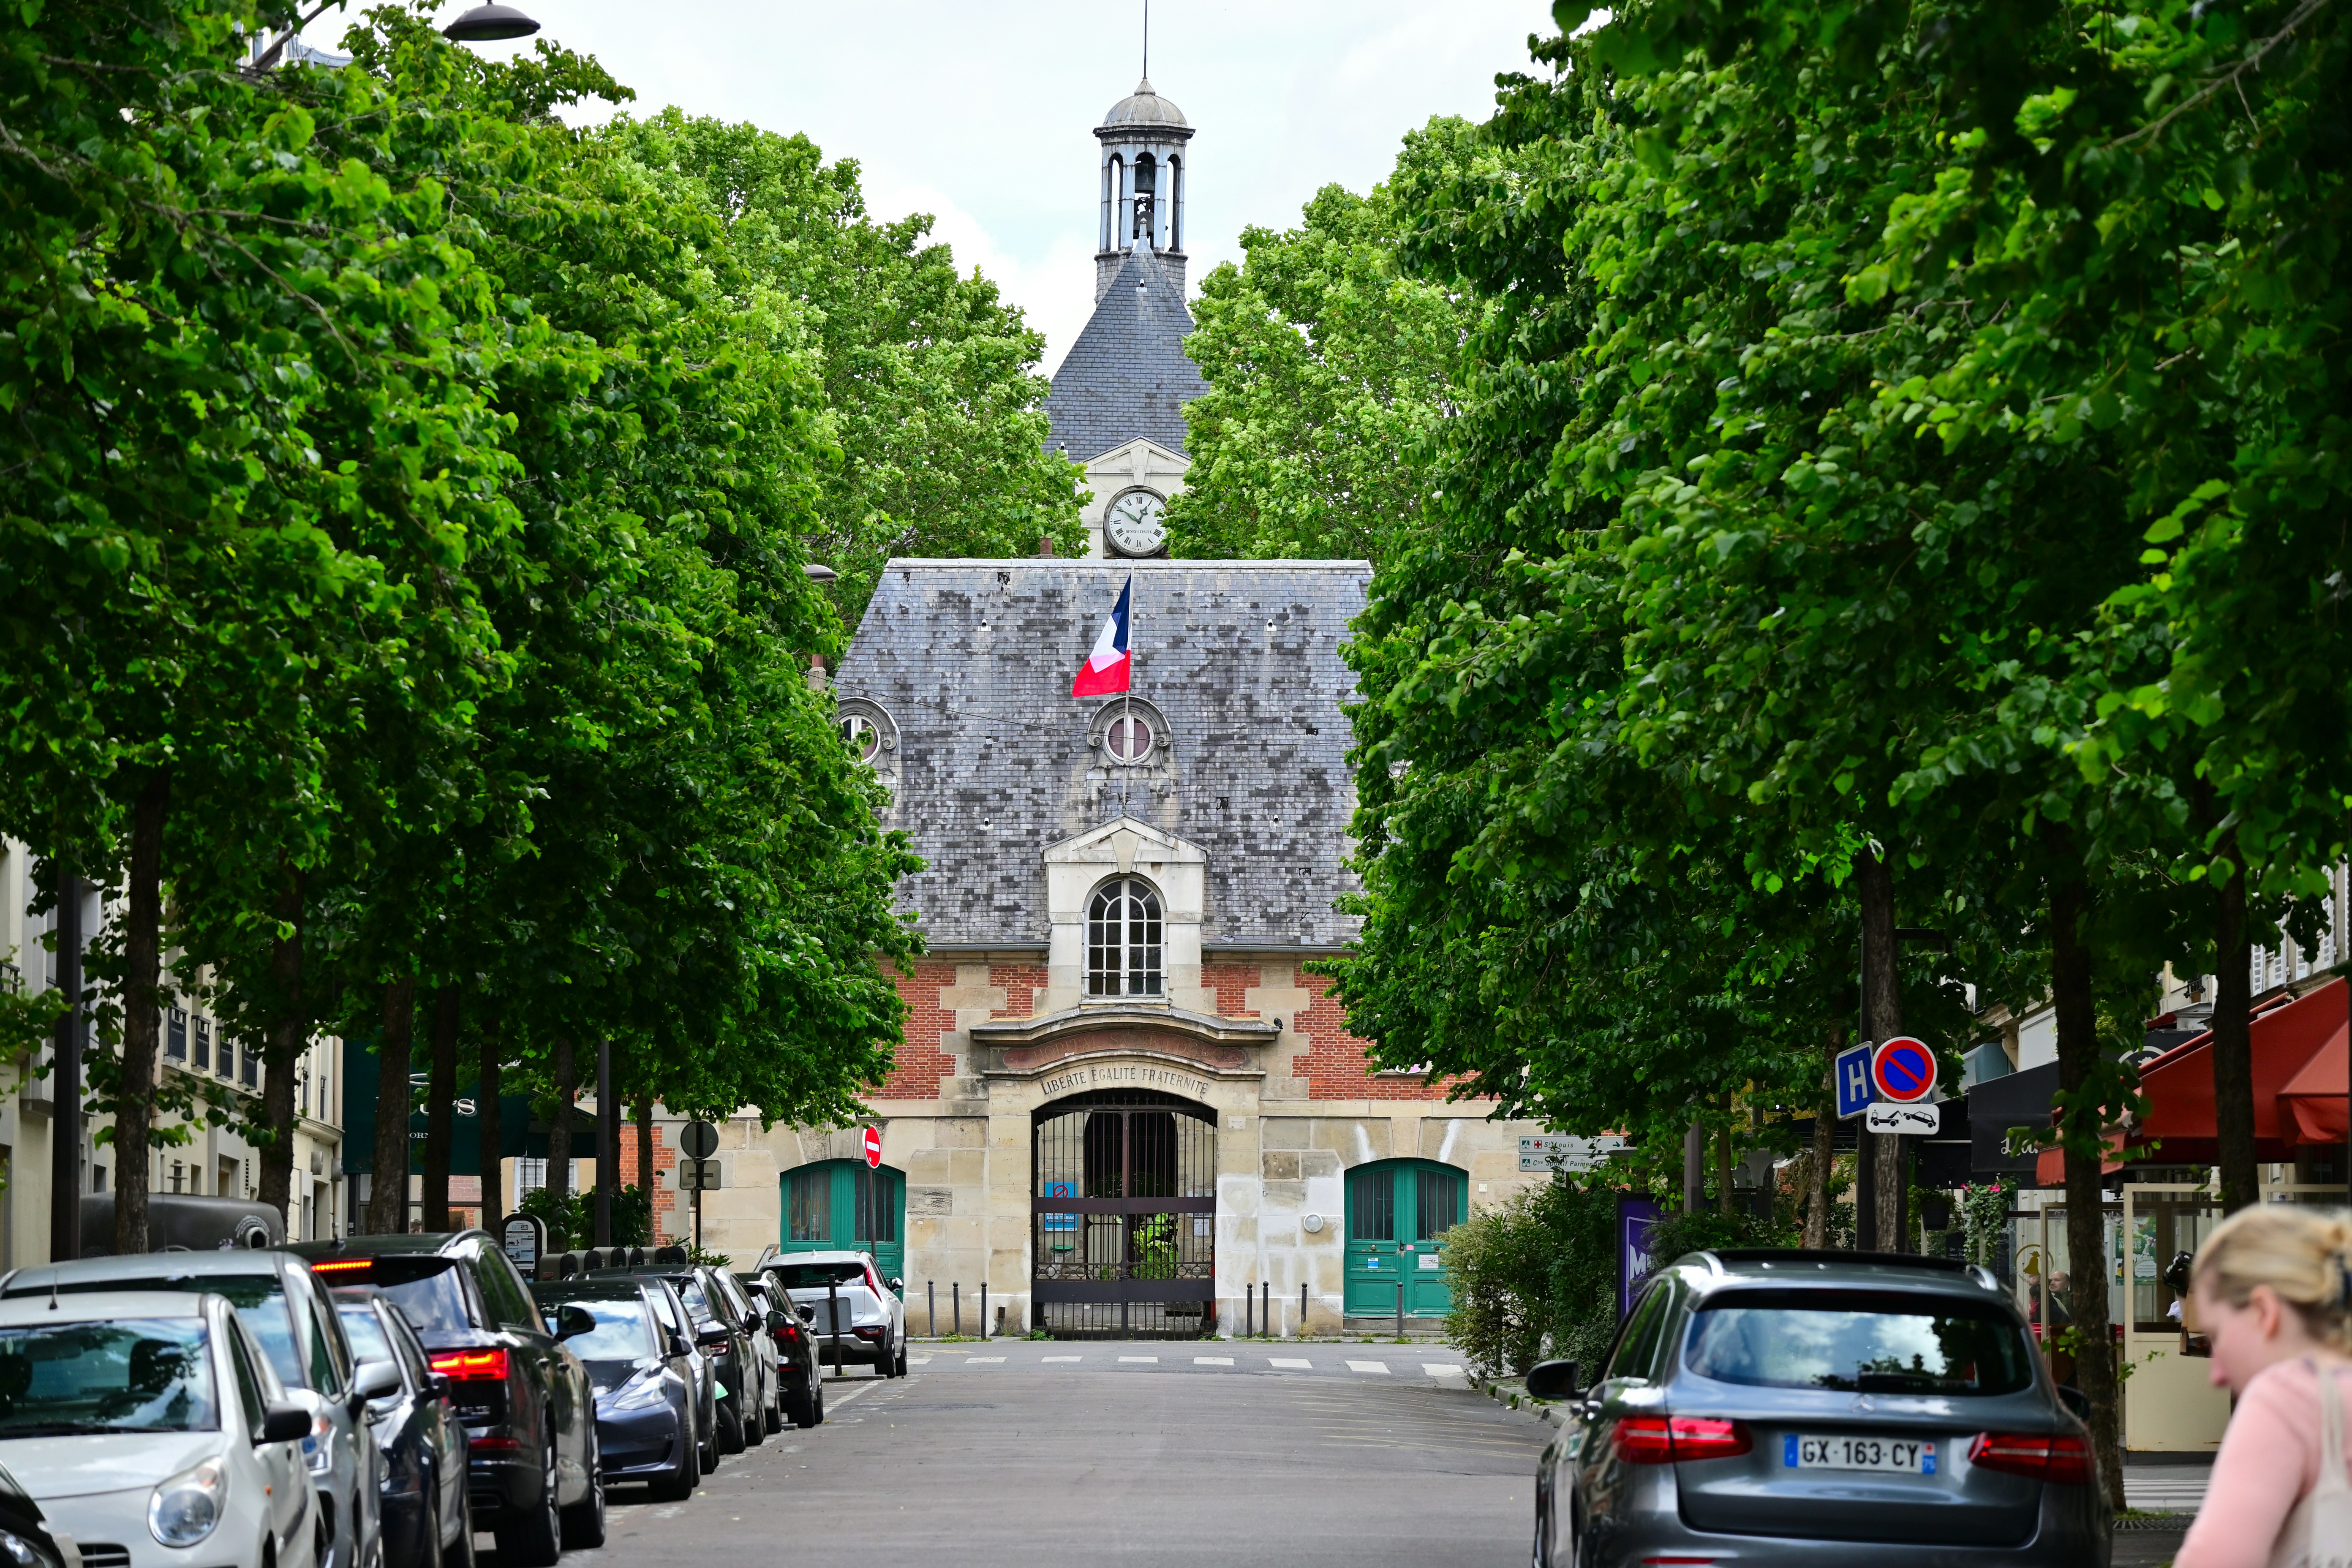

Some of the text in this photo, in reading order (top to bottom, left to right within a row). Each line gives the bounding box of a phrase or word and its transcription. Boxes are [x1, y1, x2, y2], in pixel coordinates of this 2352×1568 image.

[1041, 1069, 1086, 1095] LIBERTÉ
[1091, 1067, 1136, 1082] ÉGALITÉ
[1848, 1059, 1868, 1102] H
